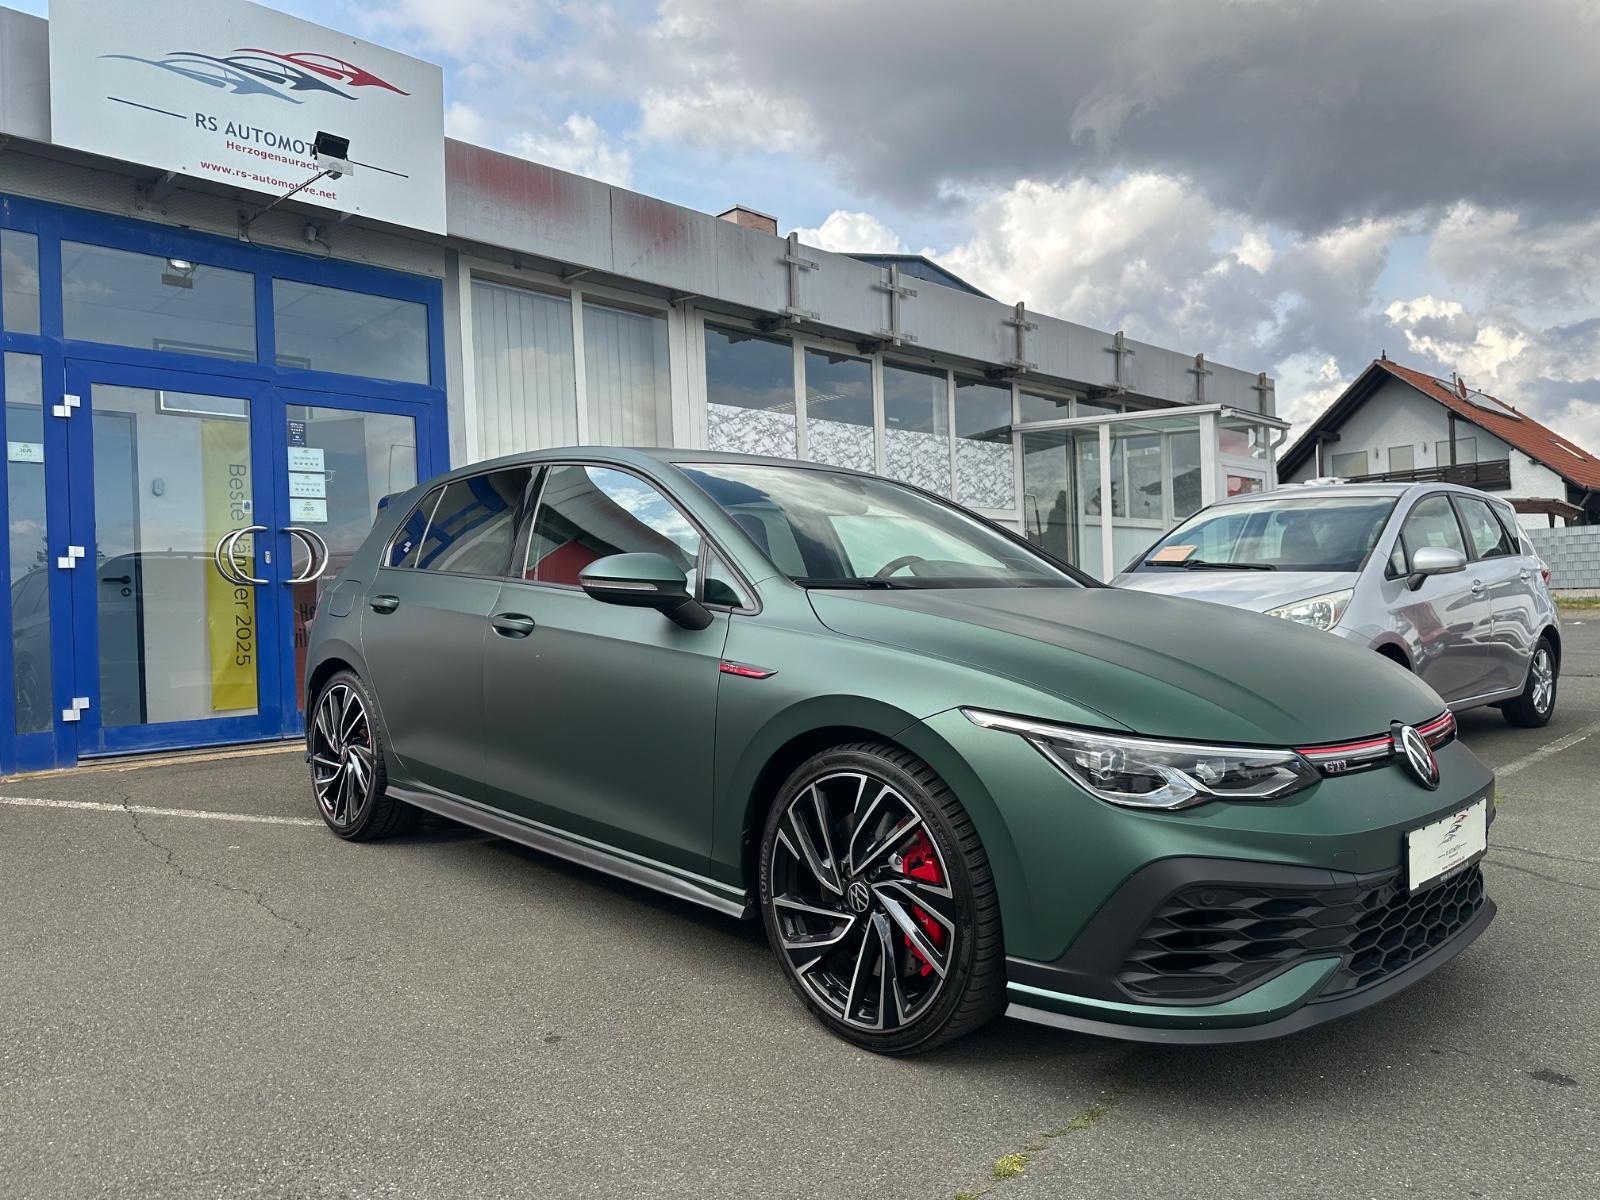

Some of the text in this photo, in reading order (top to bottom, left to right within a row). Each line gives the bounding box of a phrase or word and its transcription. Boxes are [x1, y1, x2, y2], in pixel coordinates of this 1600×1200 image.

[195, 112, 316, 157] RS AUTOMOT
[225, 140, 320, 172] Herzogenaurach
[200, 160, 337, 200] www.rs-automotve.net
[229, 463, 246, 522] Beste
[235, 614, 252, 666] 2025
